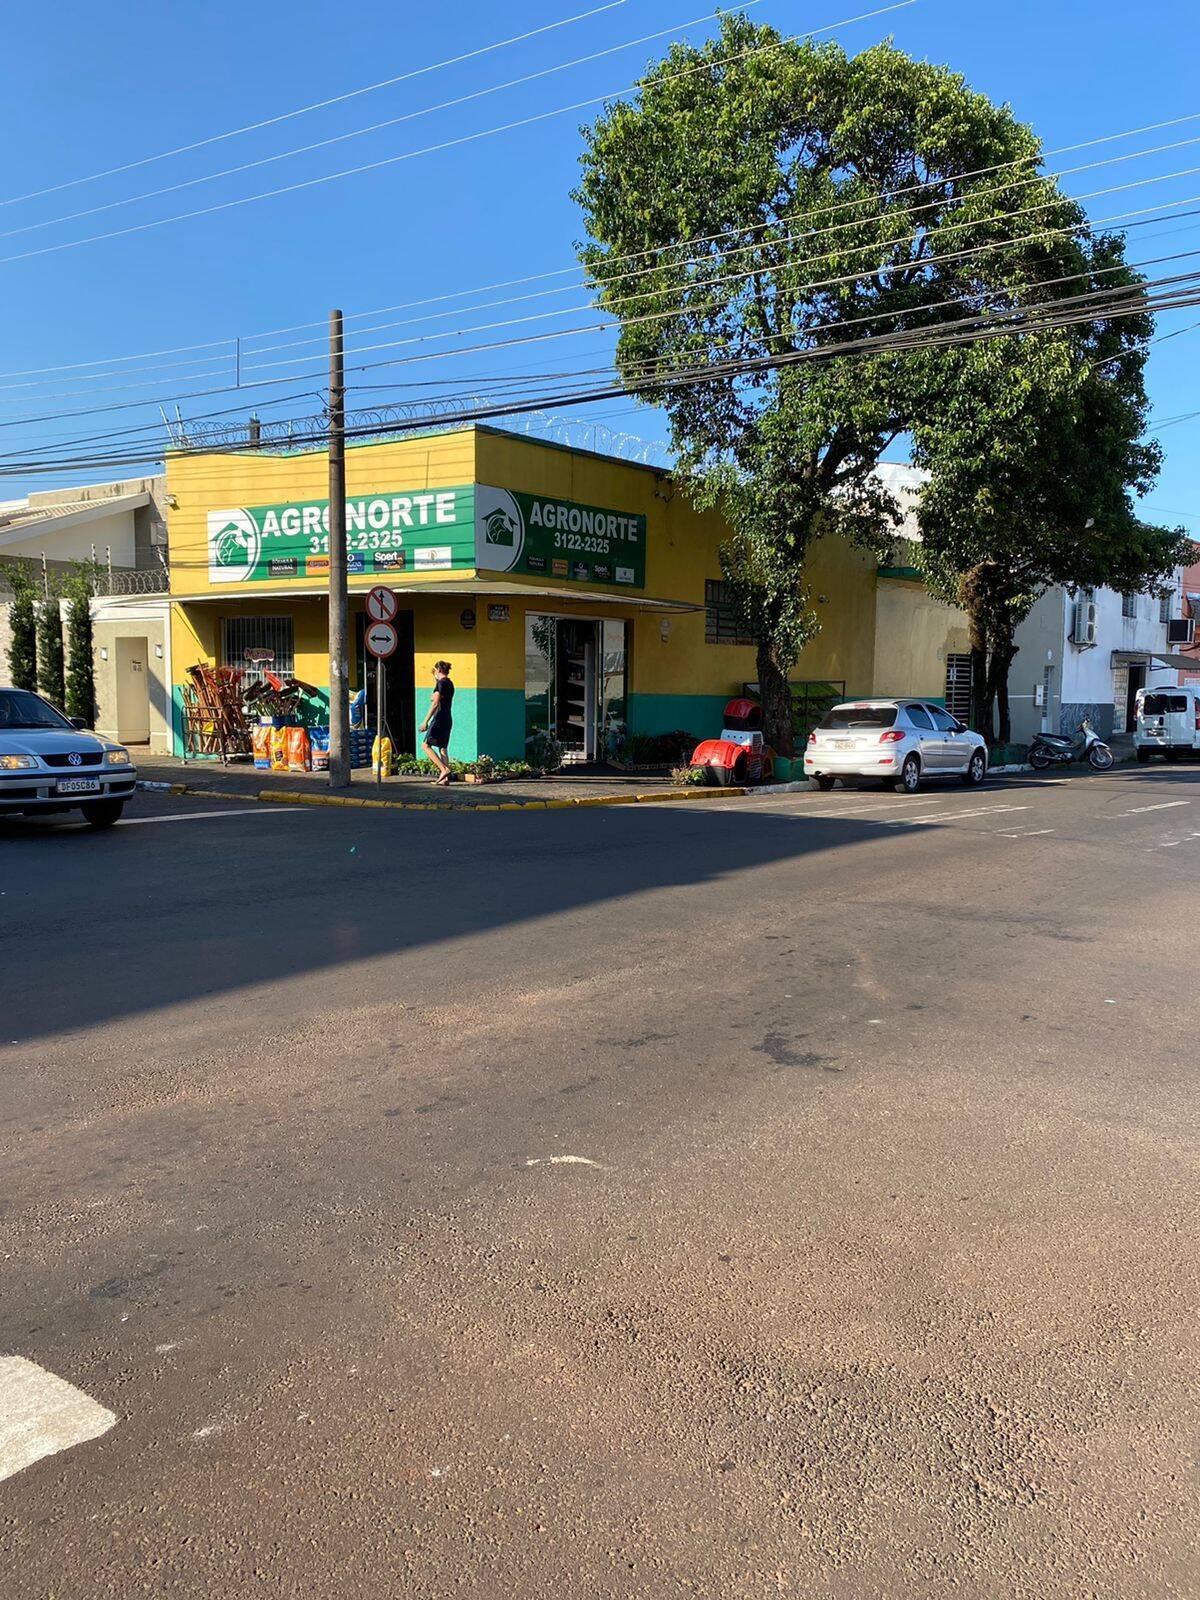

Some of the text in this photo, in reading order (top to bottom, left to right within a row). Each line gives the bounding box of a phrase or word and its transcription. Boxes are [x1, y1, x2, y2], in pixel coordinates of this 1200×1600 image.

[529, 501, 638, 542] AGRONORTE
[310, 529, 403, 554] 312-2325
[554, 532, 610, 554] 3122-2325
